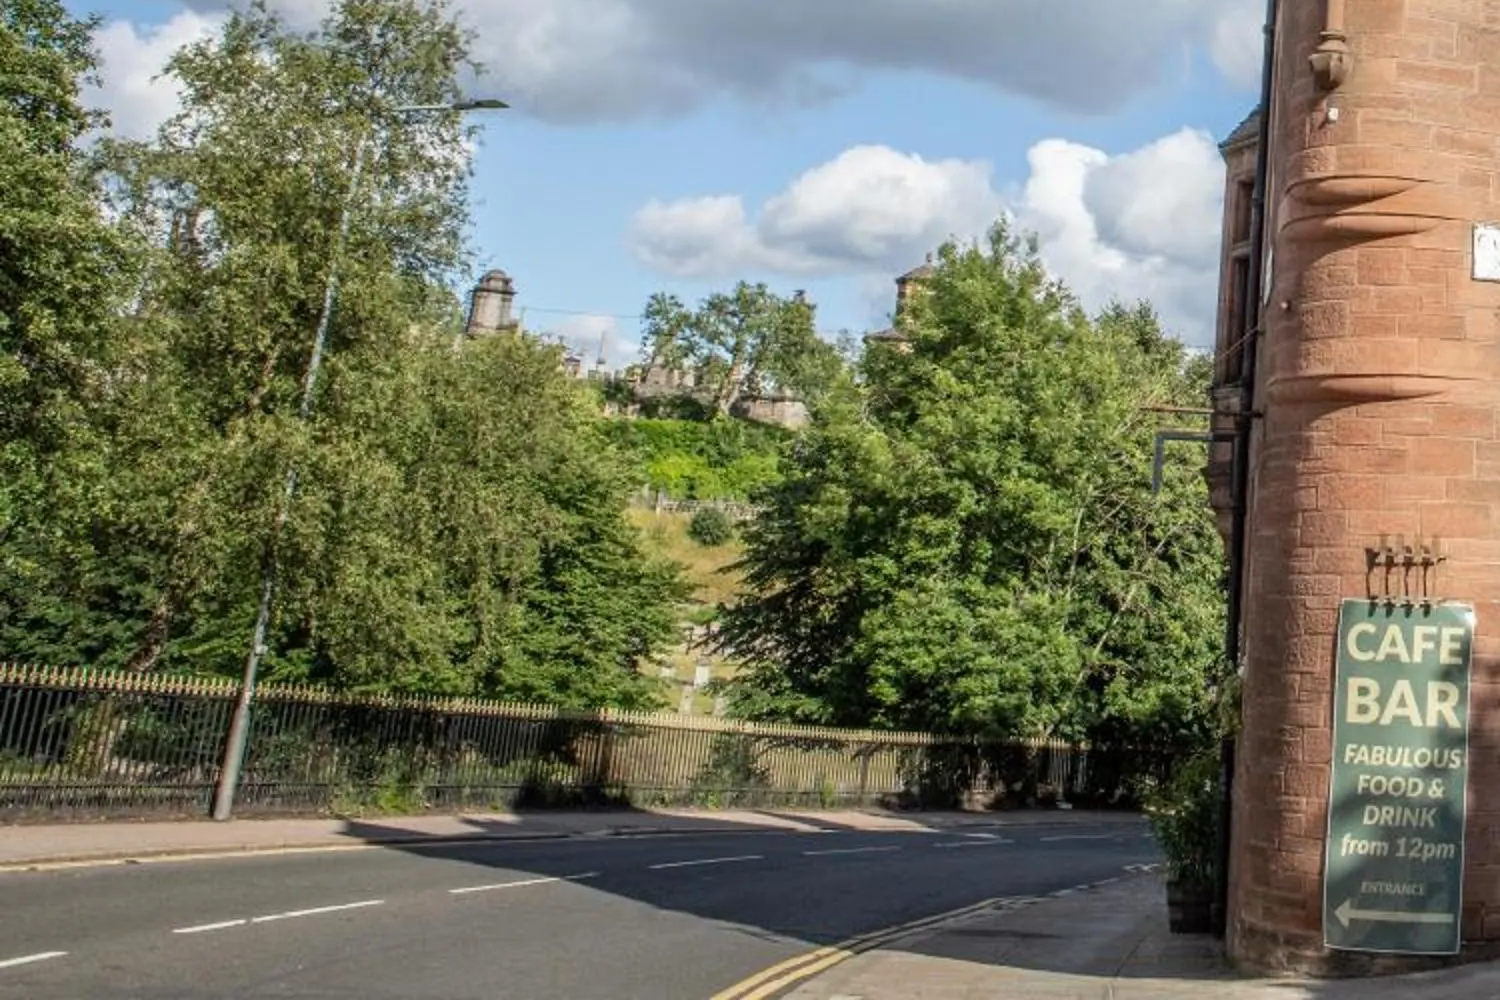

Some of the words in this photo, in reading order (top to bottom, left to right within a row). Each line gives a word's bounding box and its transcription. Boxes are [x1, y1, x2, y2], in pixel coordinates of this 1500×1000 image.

[1346, 622, 1465, 665] CAFE
[1345, 677, 1461, 729] BAR
[1343, 743, 1462, 770] FABULOUS
[1357, 774, 1424, 798] FOOD
[1428, 778, 1445, 799] &
[1362, 804, 1437, 828] DRINK
[1340, 833, 1390, 857] from
[1395, 836, 1456, 861] 12pm
[1360, 880, 1426, 897] ENTRANCE
